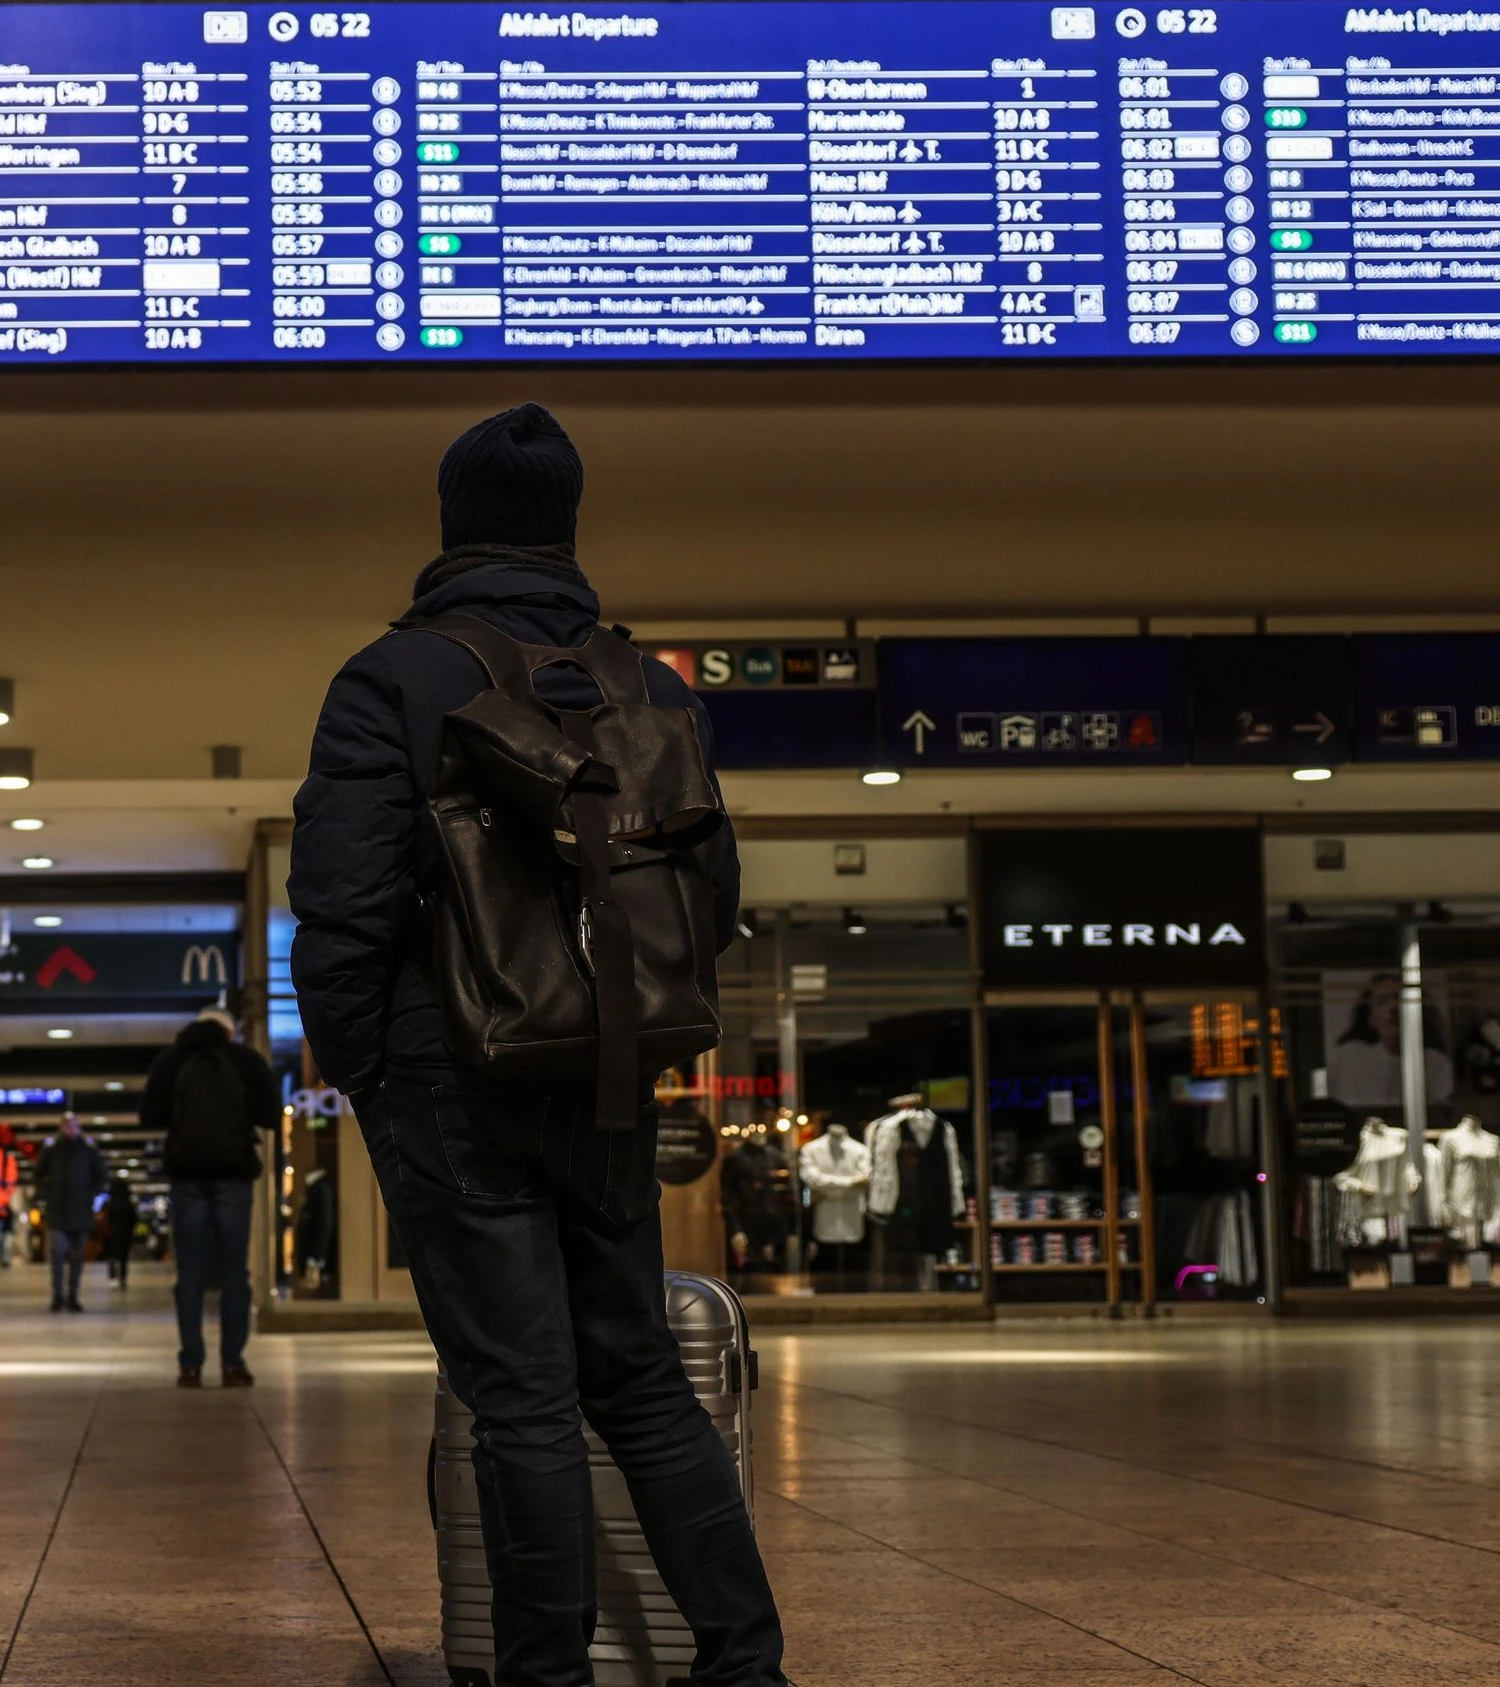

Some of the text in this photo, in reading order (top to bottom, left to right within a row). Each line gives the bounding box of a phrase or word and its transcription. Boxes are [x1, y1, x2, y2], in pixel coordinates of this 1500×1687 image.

[311, 14, 370, 37] 05 22
[500, 13, 658, 40] Abfahrt Departure
[1157, 10, 1216, 33] 05 22
[1345, 9, 1500, 35] Abfahrt Departure
[57, 80, 106, 106] (Sieg)
[1021, 78, 1035, 98] 1
[17, 112, 47, 134] Hbf
[271, 113, 321, 132] 05:54
[809, 110, 905, 130] Marienheide
[271, 143, 322, 163] 05:54
[810, 141, 897, 161] Düsseldorf
[1122, 137, 1172, 159] 06:02
[173, 174, 186, 194] 7
[811, 171, 887, 191] Mainz Hbf
[1123, 170, 1174, 190] 06:03
[17, 206, 47, 226] Hbf
[173, 205, 186, 225] 8
[812, 200, 896, 223] Köln/Bonn
[26, 234, 100, 260] Gladbach
[273, 235, 323, 255] 05:57
[813, 232, 900, 253] Düsseldorf
[71, 267, 101, 287] Hbf
[814, 261, 983, 286] Mönchengladbach Hbf
[1028, 262, 1042, 282] 8
[1127, 261, 1177, 281] 06:07
[274, 297, 324, 316] 06:00
[1128, 290, 1179, 312] 06:07
[17, 328, 66, 353] (Sieg)
[274, 328, 325, 347] 06:00
[816, 325, 864, 345] Düren
[1129, 323, 1180, 343] 06:07
[702, 649, 733, 685] S
[746, 662, 772, 675] Bus
[959, 732, 988, 748] WC
[1003, 923, 1247, 947] ETERNA
